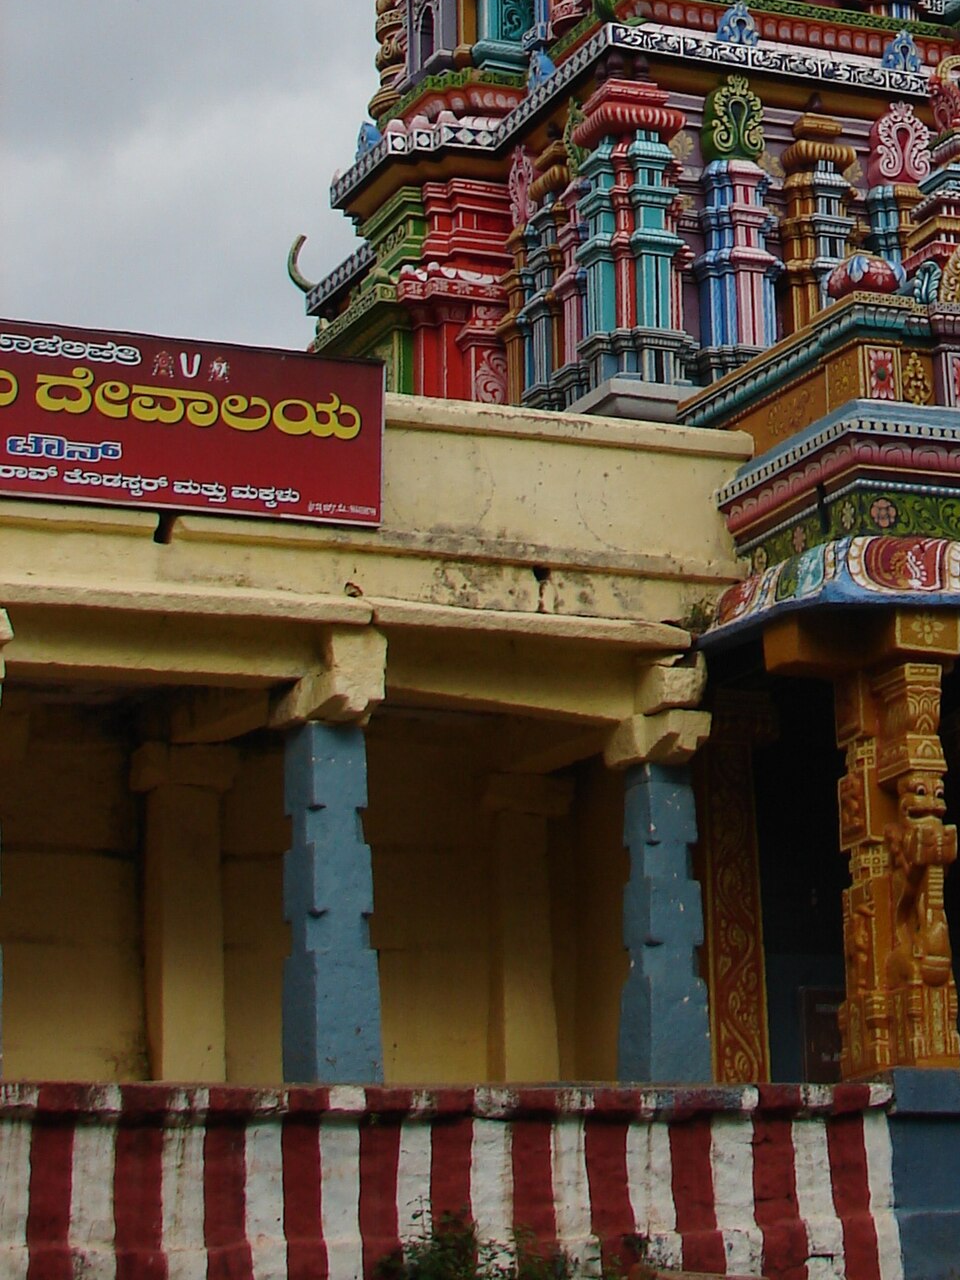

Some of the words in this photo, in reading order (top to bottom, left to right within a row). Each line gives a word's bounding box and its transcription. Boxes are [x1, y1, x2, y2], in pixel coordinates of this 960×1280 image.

[35, 367, 362, 440] ದೇವಾಲಯ
[7, 433, 122, 462] ಟೌನ್
[173, 478, 227, 502] ಮತ್ತು
[231, 483, 300, 508] ಮಕ್ಕಳು
